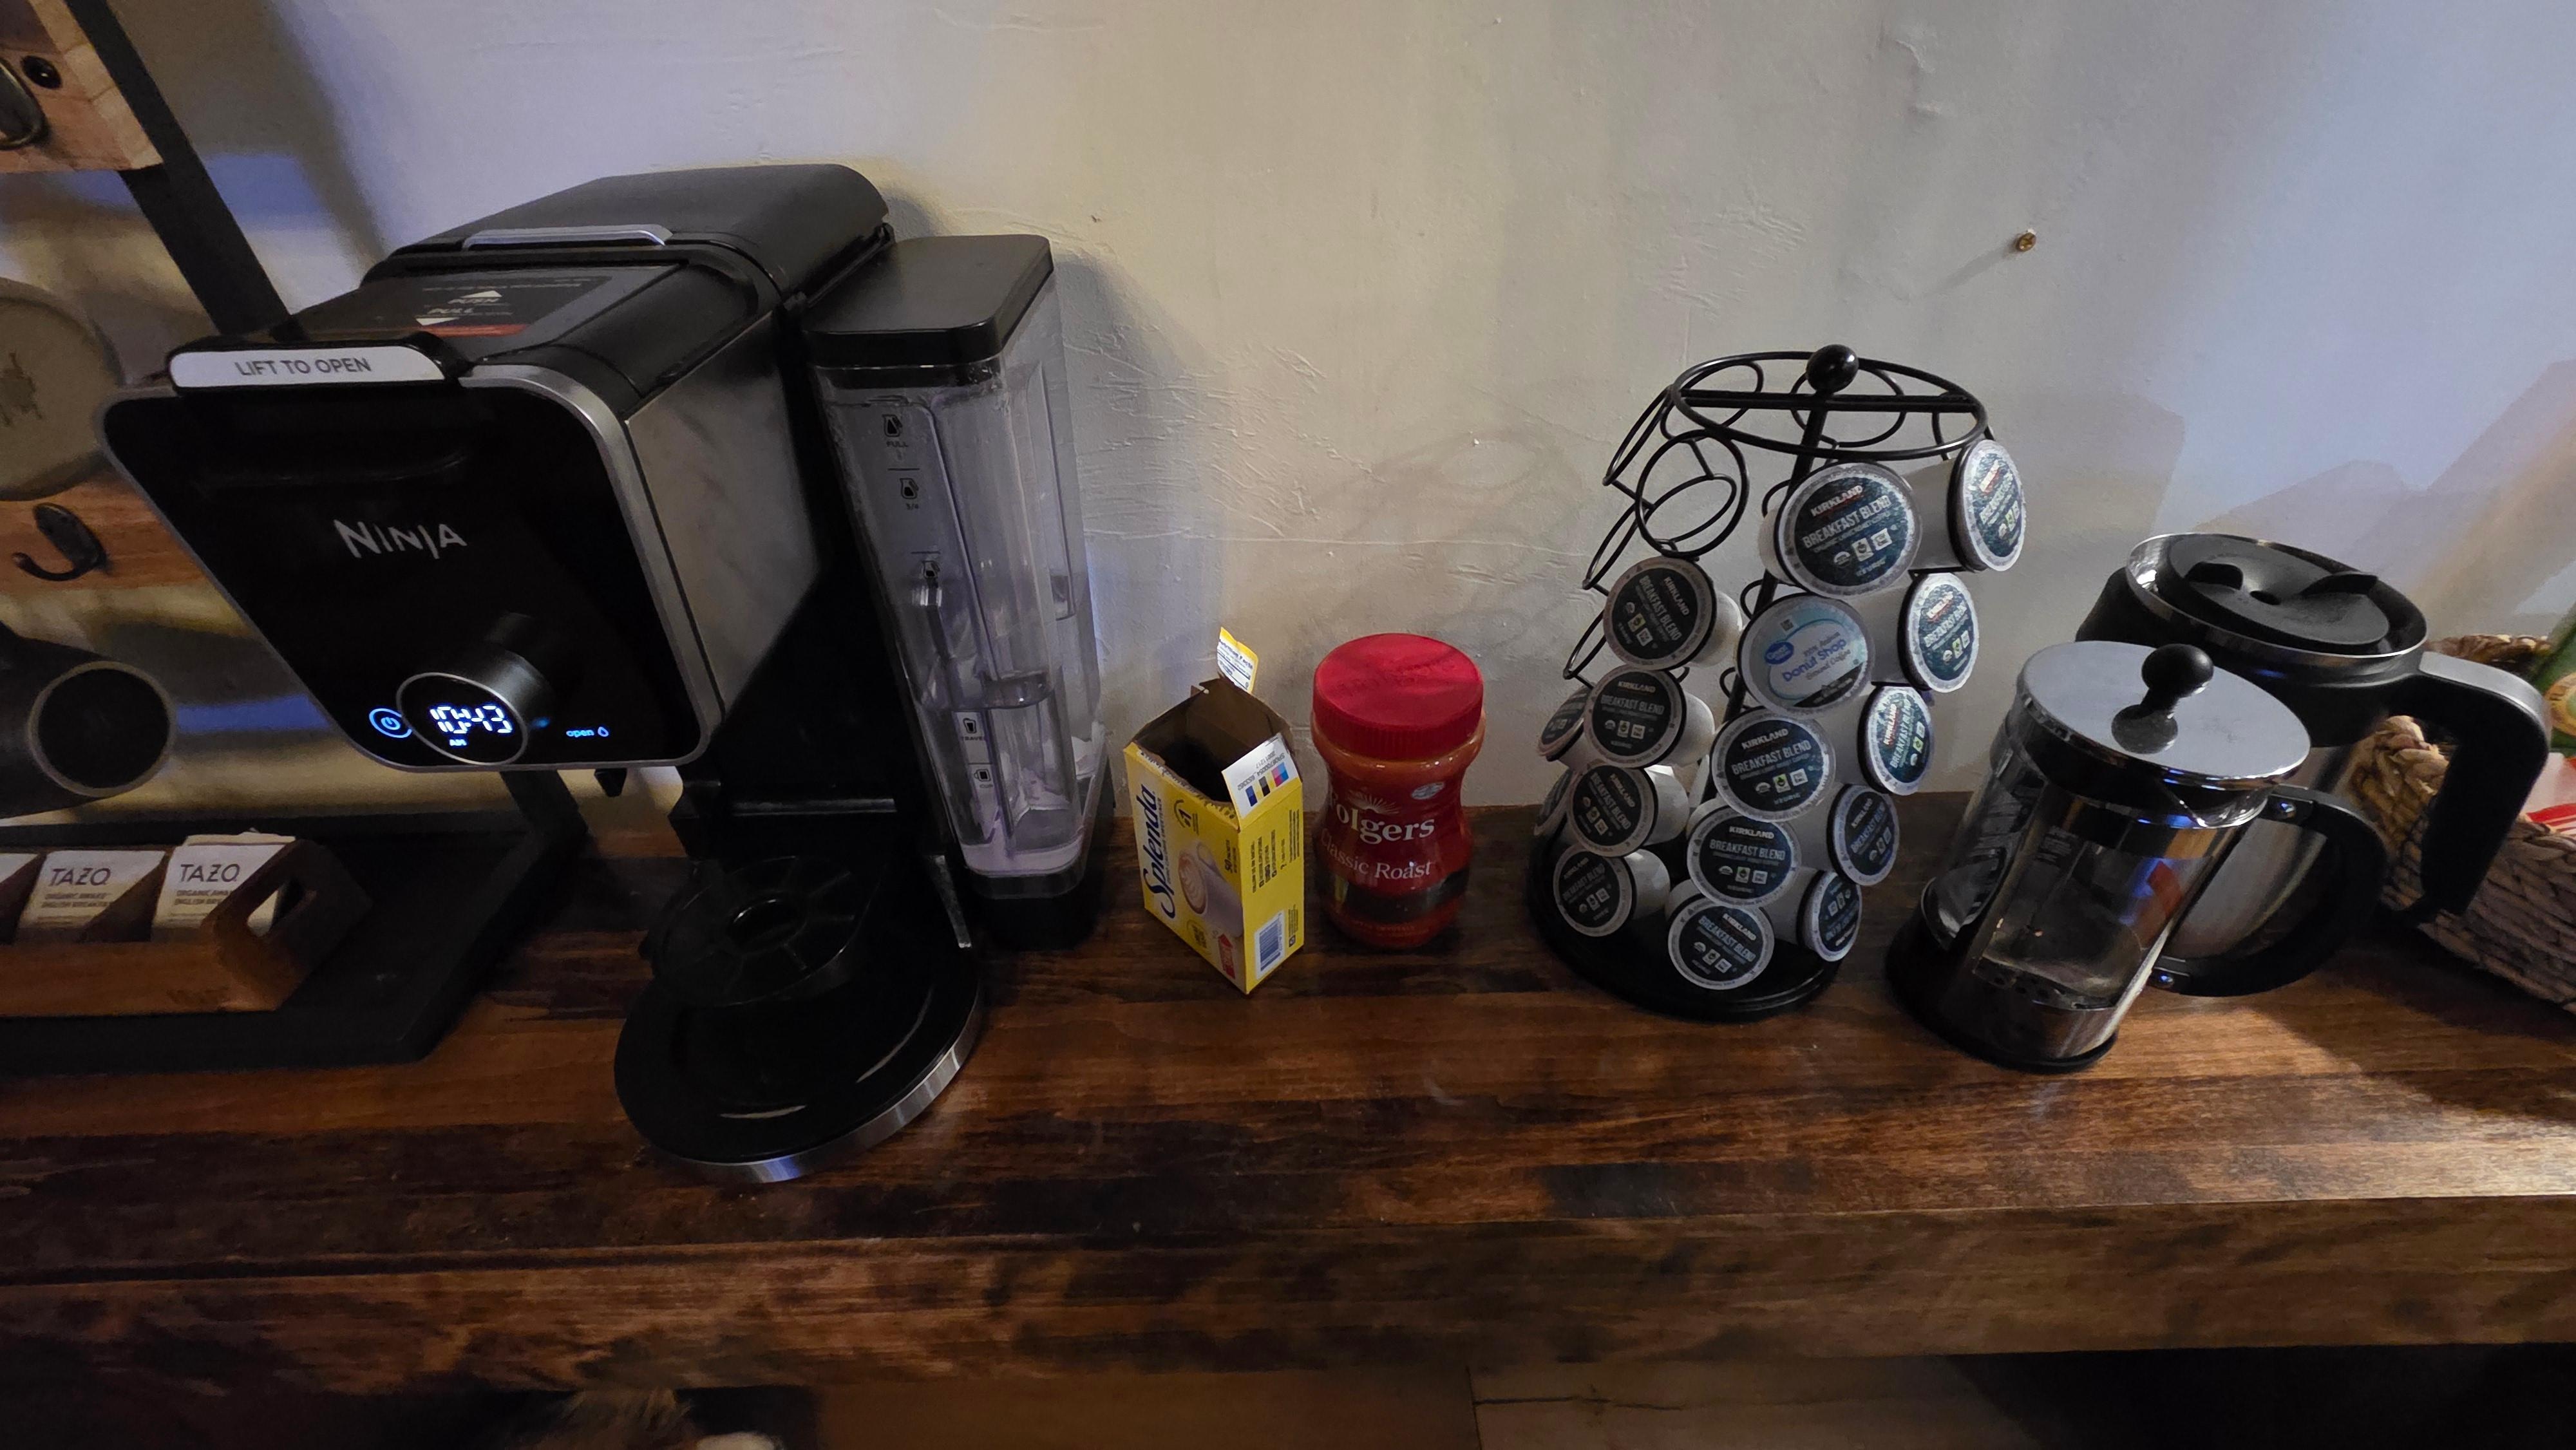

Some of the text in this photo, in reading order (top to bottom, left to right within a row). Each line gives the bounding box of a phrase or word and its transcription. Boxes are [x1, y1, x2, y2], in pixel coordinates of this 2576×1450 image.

[234, 358, 372, 375] LIFT TO OPEN
[1810, 485, 1864, 517] KIRKLAND
[1802, 511, 1861, 549] BREAKFAST
[1859, 494, 1892, 520] BLEND
[334, 519, 468, 560] NINJA
[1639, 575, 1669, 617] BREAKFAST
[1659, 614, 1683, 641] BLEND
[1663, 576, 1690, 617] KIRKLAND
[1782, 638, 1847, 682] Donut Shop
[1617, 681, 1657, 694] KIRKLAND
[429, 704, 513, 734] 10:43
[1600, 694, 1640, 710] BREAKFAST
[1638, 700, 1665, 715] BLEND
[565, 729, 594, 738] open
[1741, 728, 1790, 750] KIRKLAND
[1889, 722, 1909, 769] BREAKFAST
[1730, 750, 1783, 776] BREAKFAST
[1781, 740, 1813, 759] BLEND
[1728, 825, 1776, 840] KIRKLAND
[1135, 783, 1177, 919] Splenda
[1320, 827, 1370, 875] Classic
[1374, 859, 1434, 880] Roast
[1709, 838, 1759, 857] BREAKFAST
[1758, 847, 1786, 861] BLEND
[48, 867, 111, 887] TAZO
[180, 863, 241, 883] TAZO
